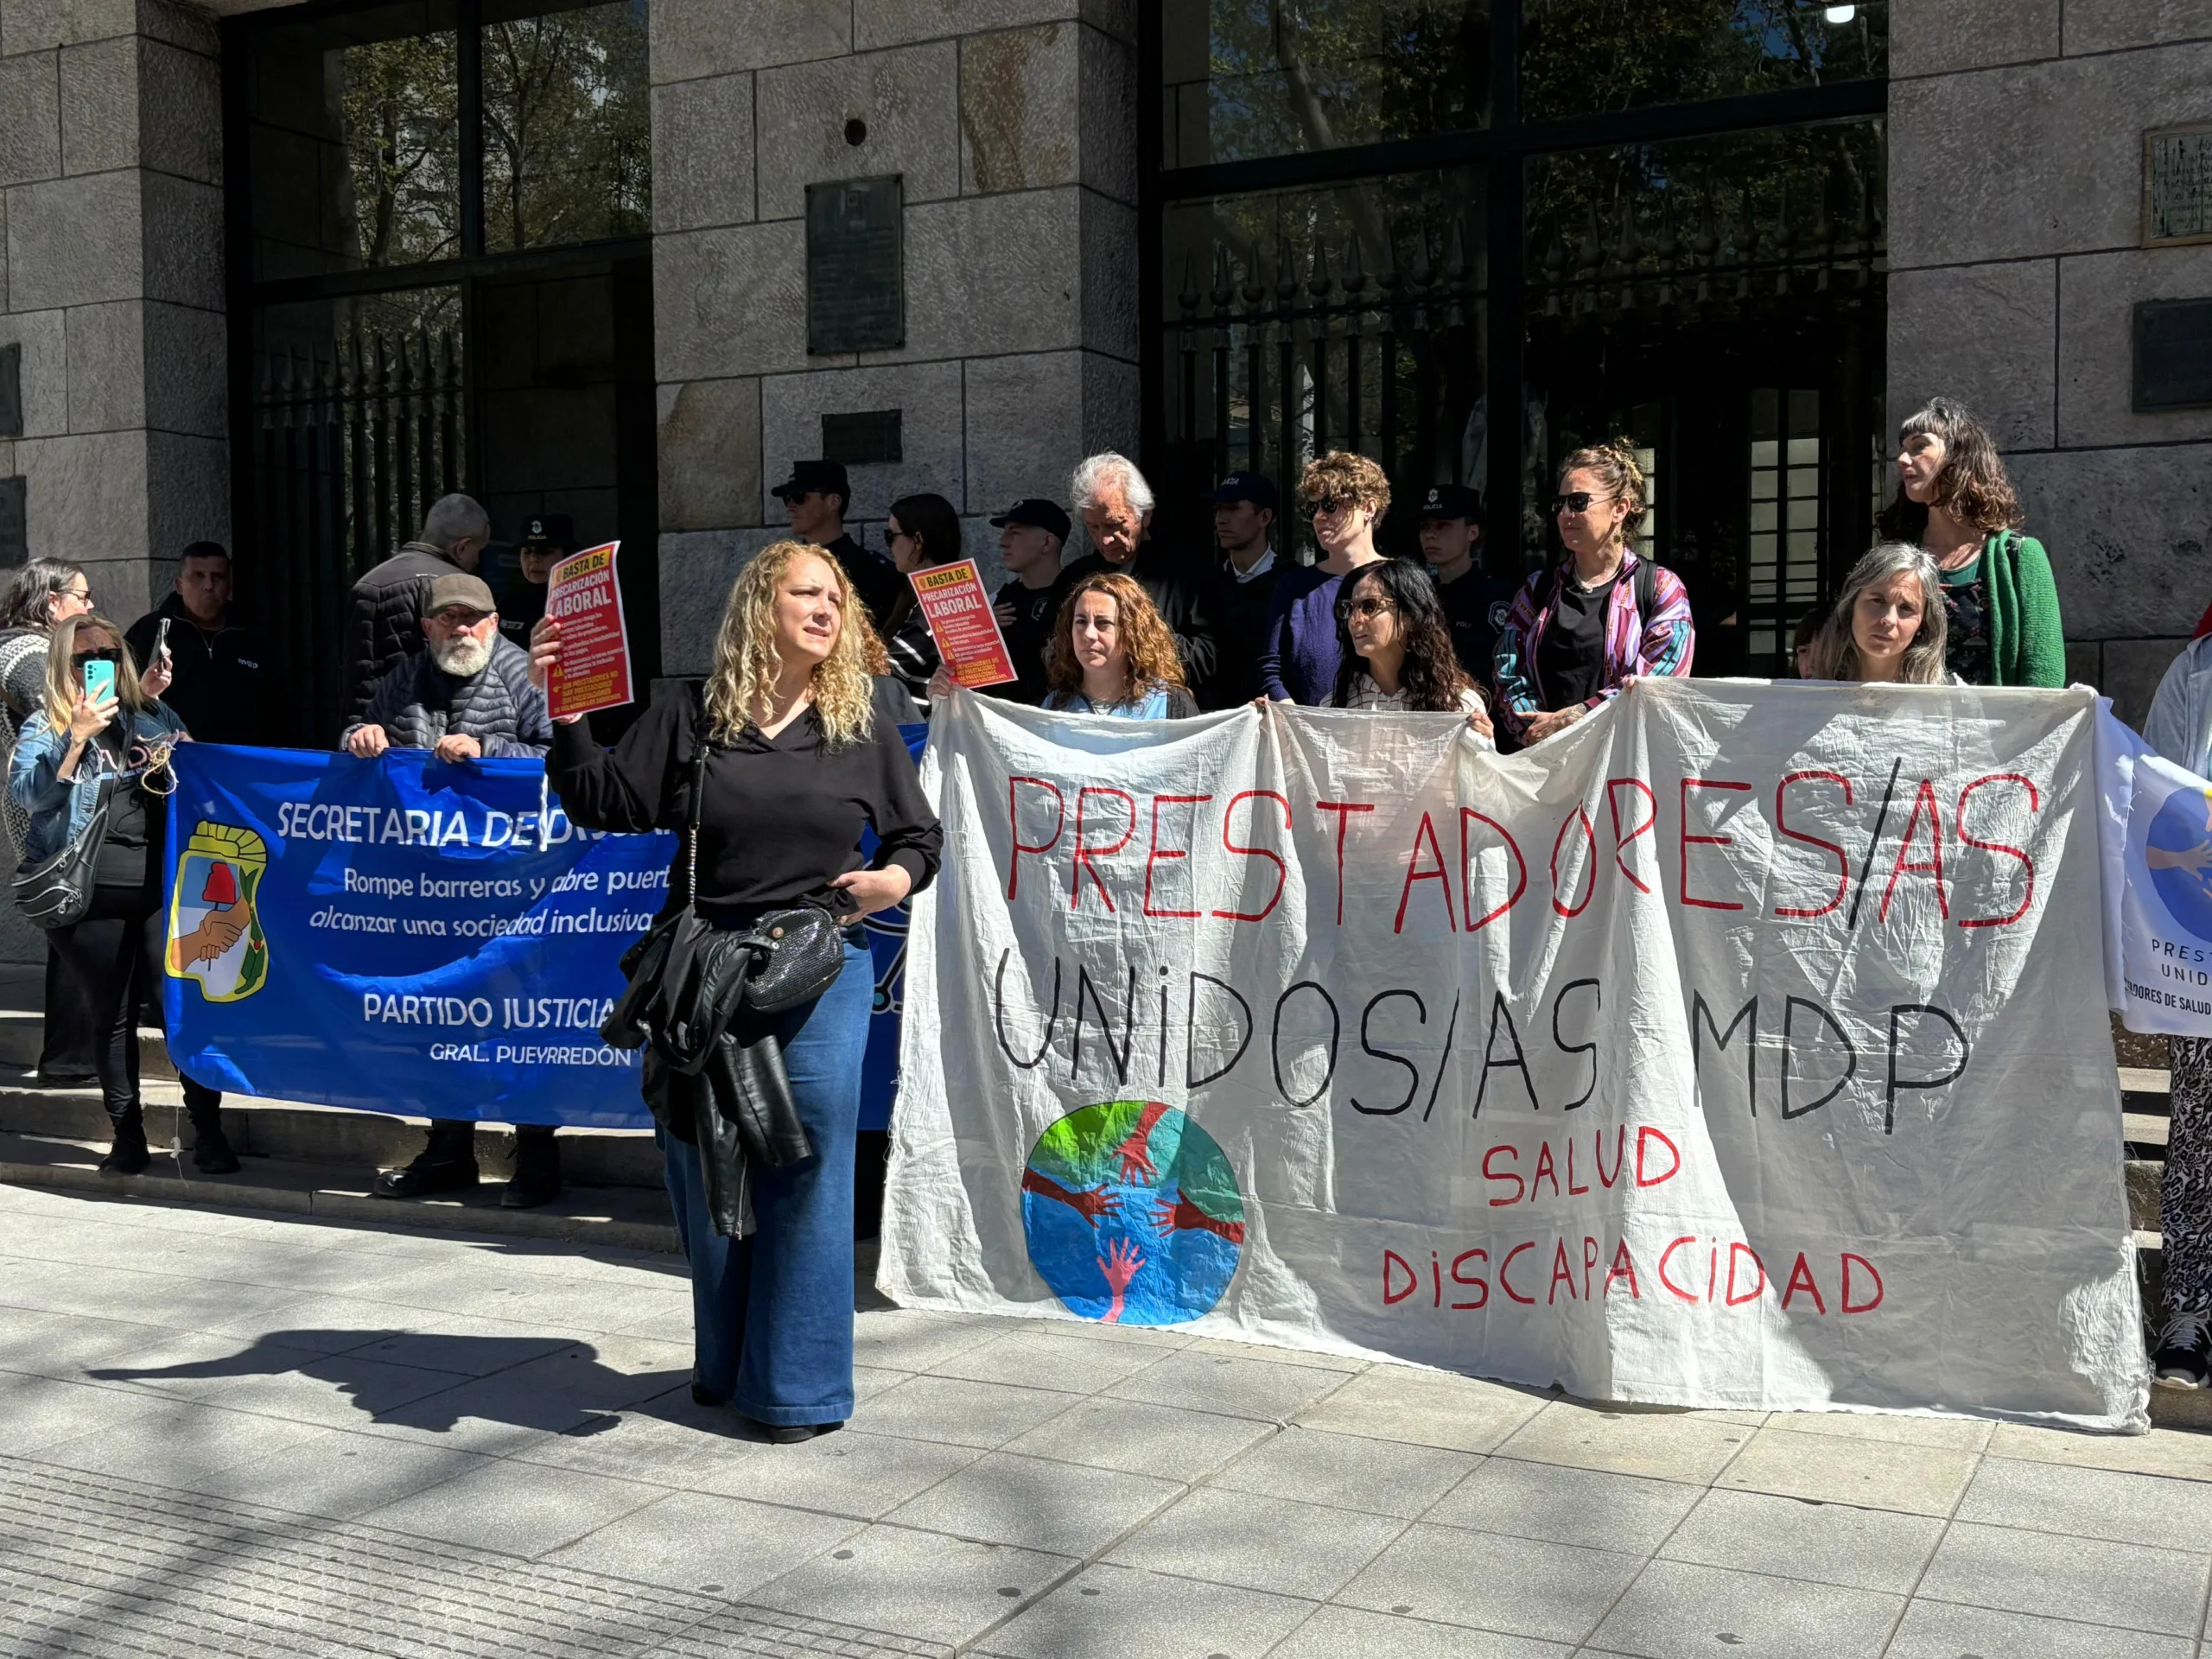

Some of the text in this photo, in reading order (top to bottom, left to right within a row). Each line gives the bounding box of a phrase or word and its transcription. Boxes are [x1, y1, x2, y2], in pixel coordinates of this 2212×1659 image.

[563, 553, 605, 580] BASTA DE
[926, 569, 969, 587] BASTA DE
[922, 582, 977, 602] PRECARIZACIÓN
[926, 594, 982, 618] LABORAL
[277, 802, 469, 847] SECRETARIA
[481, 810, 538, 847] DE
[344, 868, 414, 899] Rompe
[420, 873, 522, 899] barreras
[530, 877, 545, 900] y
[551, 868, 599, 893] abre
[309, 906, 654, 938] alcanzar una sociedad inclusiva
[2152, 938, 2212, 963] PRES
[364, 993, 493, 1028] PARTIDO
[2164, 993, 2177, 1008] DE
[2179, 997, 2211, 1015] SALUD
[429, 1043, 632, 1066] GRAL. PUEYRREDÓN
[1693, 988, 1974, 1135] MDP
[1482, 1124, 1681, 1207] SALUD
